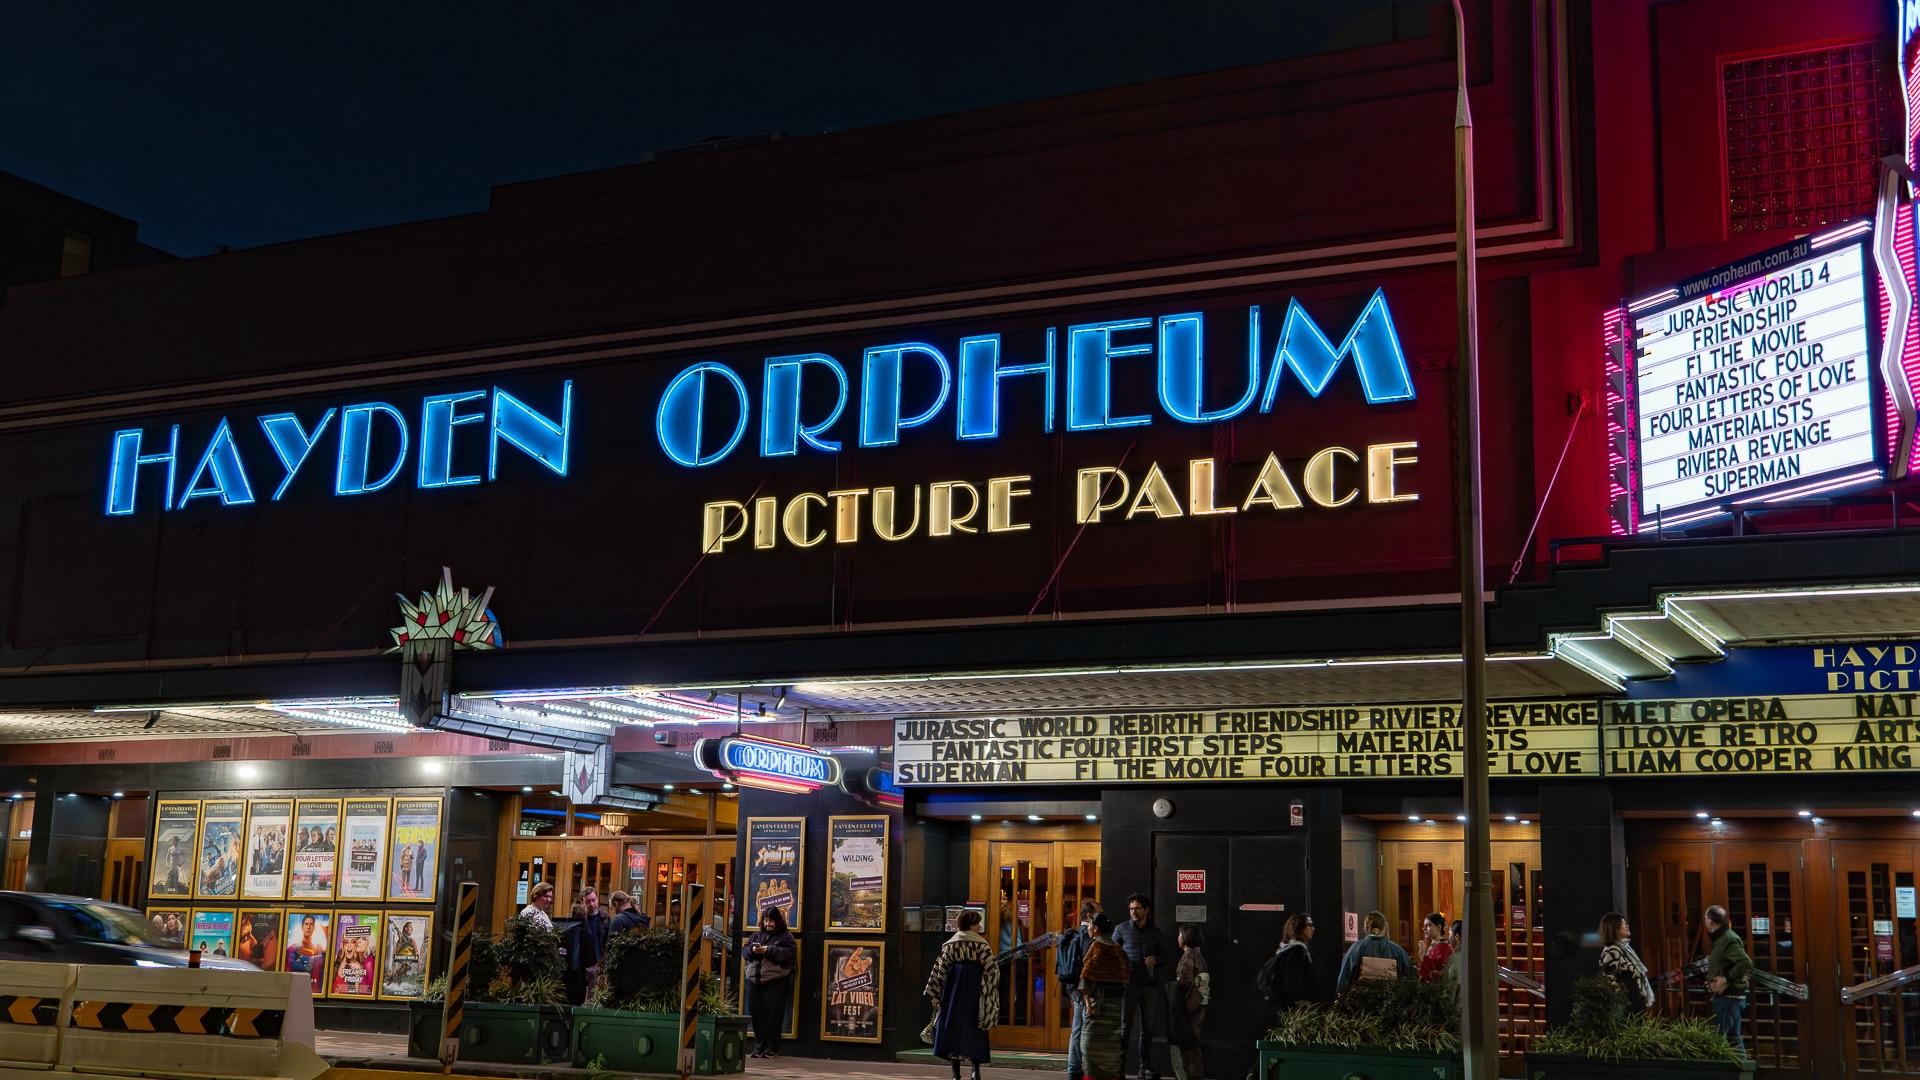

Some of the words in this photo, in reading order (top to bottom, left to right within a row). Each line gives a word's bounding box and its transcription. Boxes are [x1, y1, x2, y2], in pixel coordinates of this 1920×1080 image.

[1683, 243, 1808, 297] www.orpheum.com.au
[1664, 291, 1743, 336] JURASSIC
[1748, 268, 1813, 307] WORLD
[1818, 262, 1830, 283] 4
[1693, 299, 1797, 350] FRIENDSHIP
[1710, 341, 1743, 370] THE
[1752, 321, 1807, 358] MOVIE
[1676, 359, 1767, 404] FANTASTIC
[1776, 343, 1824, 374] FOUR
[106, 379, 573, 516] HAYDEN
[655, 286, 1416, 467] ORPHEUM
[1650, 407, 1693, 437] FOUR
[1697, 384, 1774, 423] LETTERS
[1779, 374, 1802, 399] OF
[1808, 360, 1856, 392] LOVE
[1689, 398, 1814, 451] MATERIALISTS
[1677, 444, 1740, 479] RIVIERA
[1749, 420, 1832, 458] REVENGE
[1705, 454, 1800, 497] SUPERMAN
[702, 475, 1031, 553] PICTURE
[1077, 441, 1419, 524] PALACE
[1814, 646, 1916, 667] HAYD
[1828, 670, 1920, 690] PICT
[898, 719, 1006, 741] JURASSIC
[1019, 716, 1097, 738] WORLD
[1110, 713, 1203, 736] REBIRTH
[1216, 709, 1360, 734] FRIENDSHIP
[1612, 701, 1675, 724] MET
[1691, 698, 1788, 722] OPERA
[1856, 694, 1917, 718] NAT
[932, 740, 1053, 762] FANTASTIC
[1060, 738, 1120, 759] FOUR
[1125, 736, 1189, 758] FIRST
[1203, 734, 1282, 756] STEPS
[1337, 729, 1528, 753] MATERIALTS
[1618, 726, 1625, 748] I
[1632, 725, 1705, 748] LOVE
[1720, 722, 1818, 746] RETRO
[1854, 719, 1920, 743] ART
[742, 745, 824, 780] ORPHEUM
[898, 761, 1026, 783] SUPERMAN
[1114, 758, 1157, 780] THE
[1165, 757, 1244, 779] MOVIE
[1260, 755, 1326, 778] FOUR
[1335, 753, 1452, 777] LETTERS
[1508, 752, 1581, 775] LOVE
[1612, 750, 1681, 773] LIAM
[1695, 748, 1813, 771] COOPER
[1834, 745, 1912, 769] KING
[1179, 873, 1204, 881] SPRINKLER
[1181, 882, 1202, 890] BOOSTER
[830, 991, 848, 1006] CAT
[850, 991, 875, 1006] VIDEO
[843, 1005, 861, 1016] FEST
